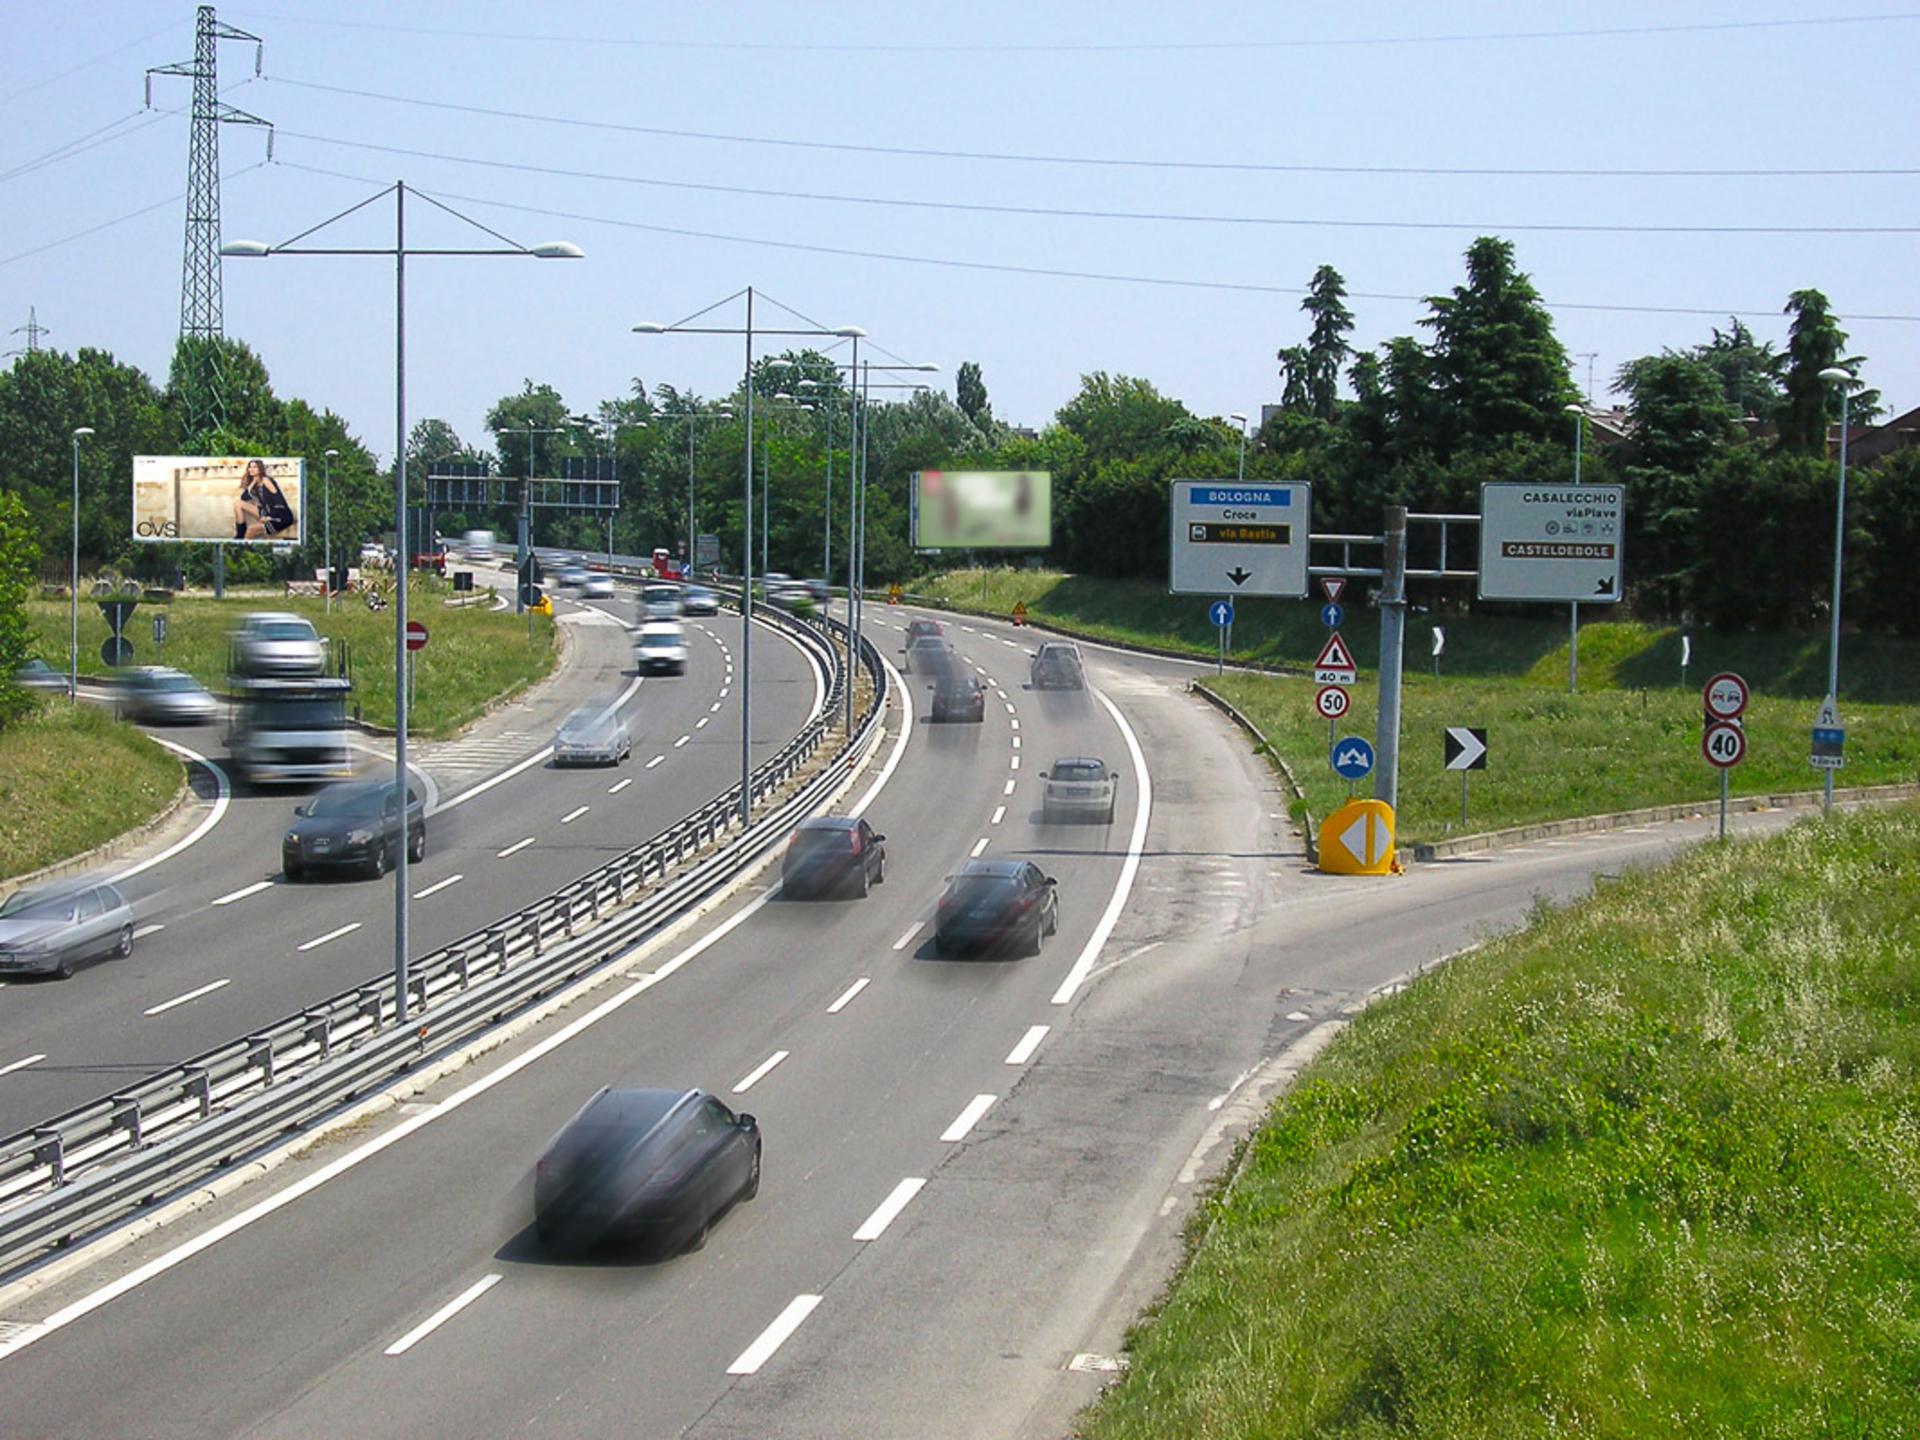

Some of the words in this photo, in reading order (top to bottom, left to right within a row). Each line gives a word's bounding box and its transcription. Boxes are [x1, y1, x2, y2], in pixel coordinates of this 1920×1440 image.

[1208, 491, 1272, 503] BOLOGNA
[1523, 492, 1617, 505] CASALECCHIO
[1223, 509, 1257, 519] Croce
[1219, 528, 1237, 539] via
[1239, 528, 1277, 540] Bastia
[1507, 545, 1609, 557] CASTELDEBOLE
[1320, 672, 1336, 681] 40
[1324, 694, 1343, 710] 50
[1711, 734, 1737, 757] 40
